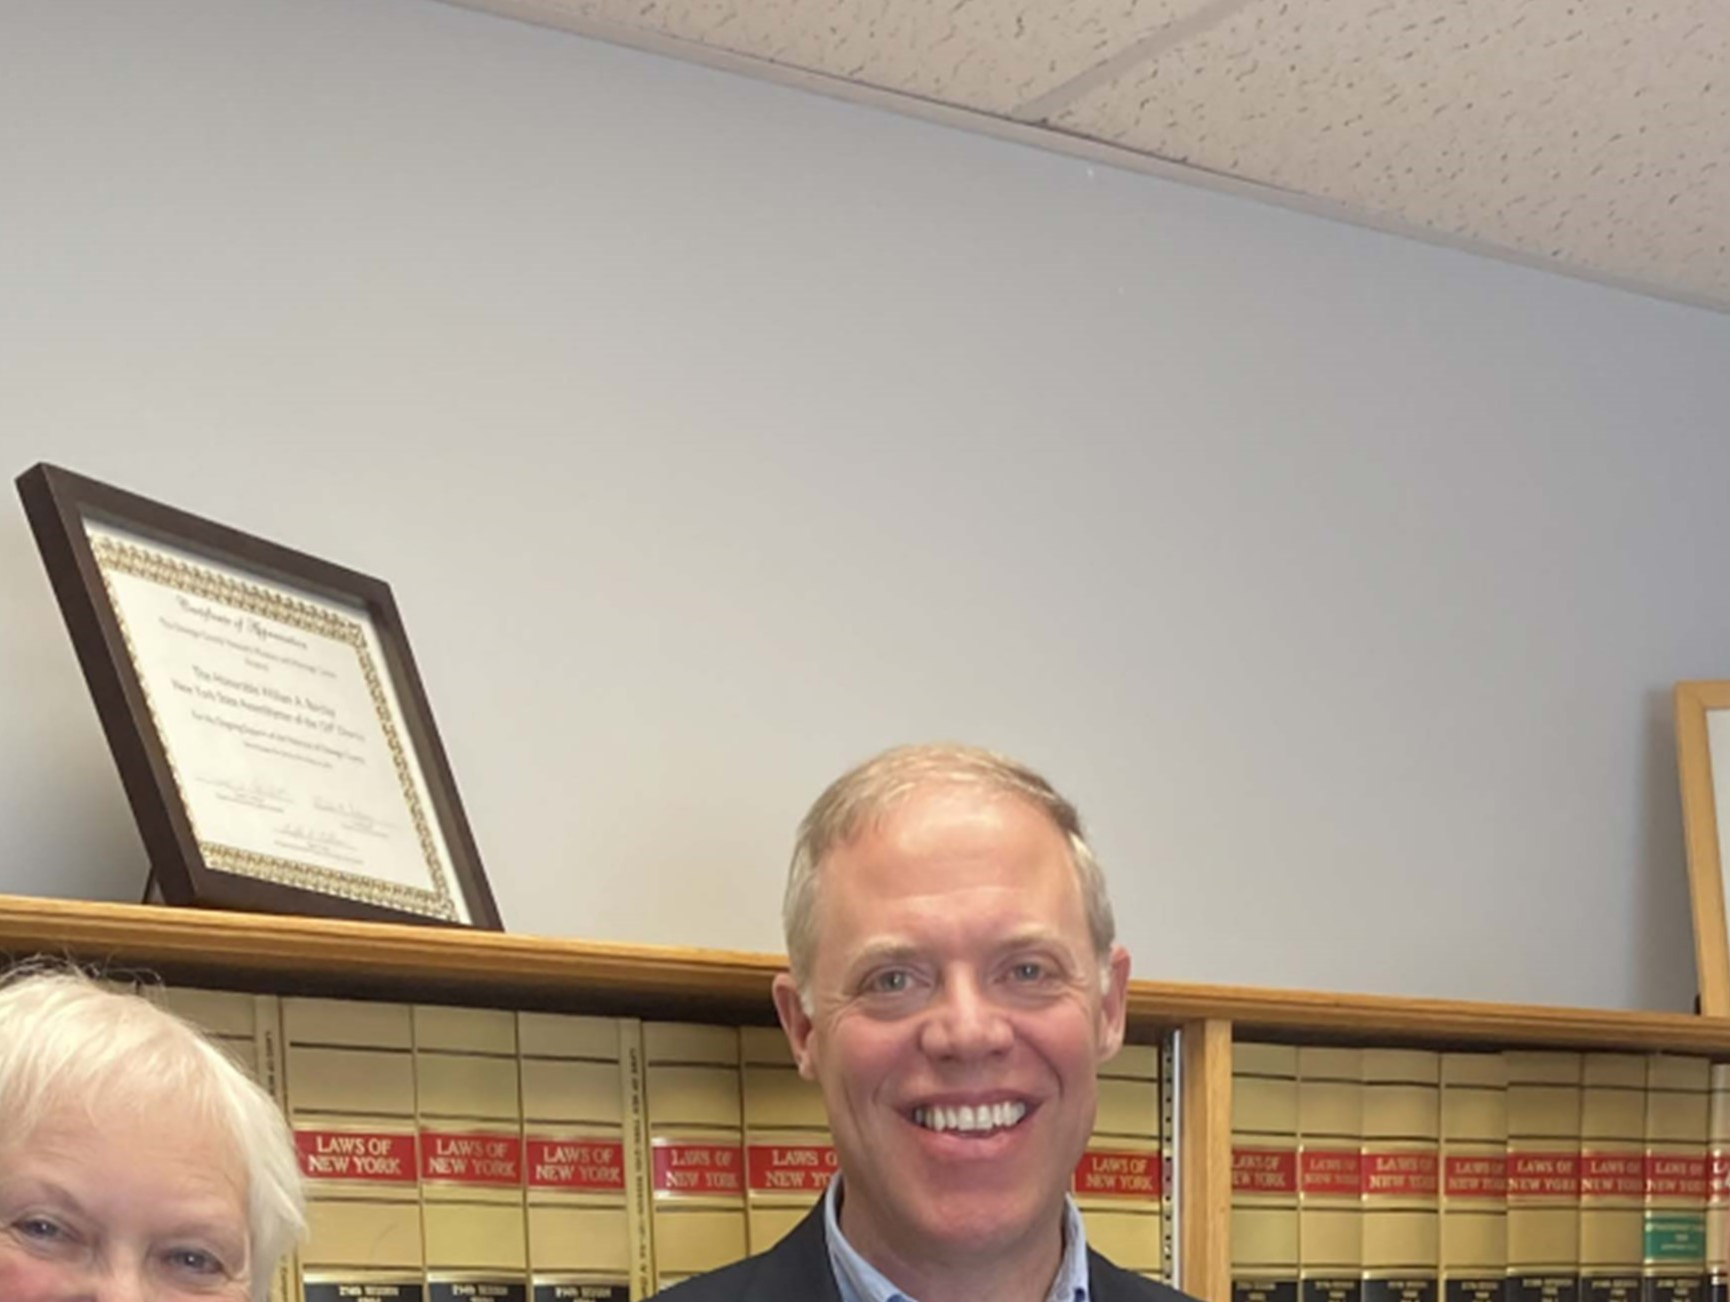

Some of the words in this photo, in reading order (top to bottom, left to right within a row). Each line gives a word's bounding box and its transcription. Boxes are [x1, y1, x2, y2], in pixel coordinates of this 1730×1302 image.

[316, 1136, 364, 1155] LAWS
[368, 1138, 392, 1155] OF
[437, 1139, 483, 1157] LAWS
[487, 1142, 508, 1157] OF
[543, 1146, 590, 1164] LAWS
[593, 1148, 614, 1164] OF
[671, 1150, 710, 1166] LAWS
[773, 1150, 818, 1165] LAWS
[308, 1155, 349, 1173] NEW
[353, 1157, 401, 1174] YORK
[429, 1158, 467, 1174] NEW
[473, 1160, 515, 1177] YORK
[1092, 1157, 1126, 1174] LAWS
[1129, 1159, 1147, 1174] OF
[1517, 1159, 1553, 1174] LAWS
[536, 1165, 574, 1181] NEW
[579, 1166, 621, 1183] YORK
[666, 1172, 699, 1187] NEW
[705, 1173, 737, 1188] YORK
[766, 1172, 804, 1187] NEW
[811, 1172, 833, 1186] YO
[1087, 1174, 1118, 1188] NEW
[1121, 1175, 1153, 1190] YORK
[1255, 1172, 1285, 1187] YORK
[1508, 1178, 1540, 1191] NEW
